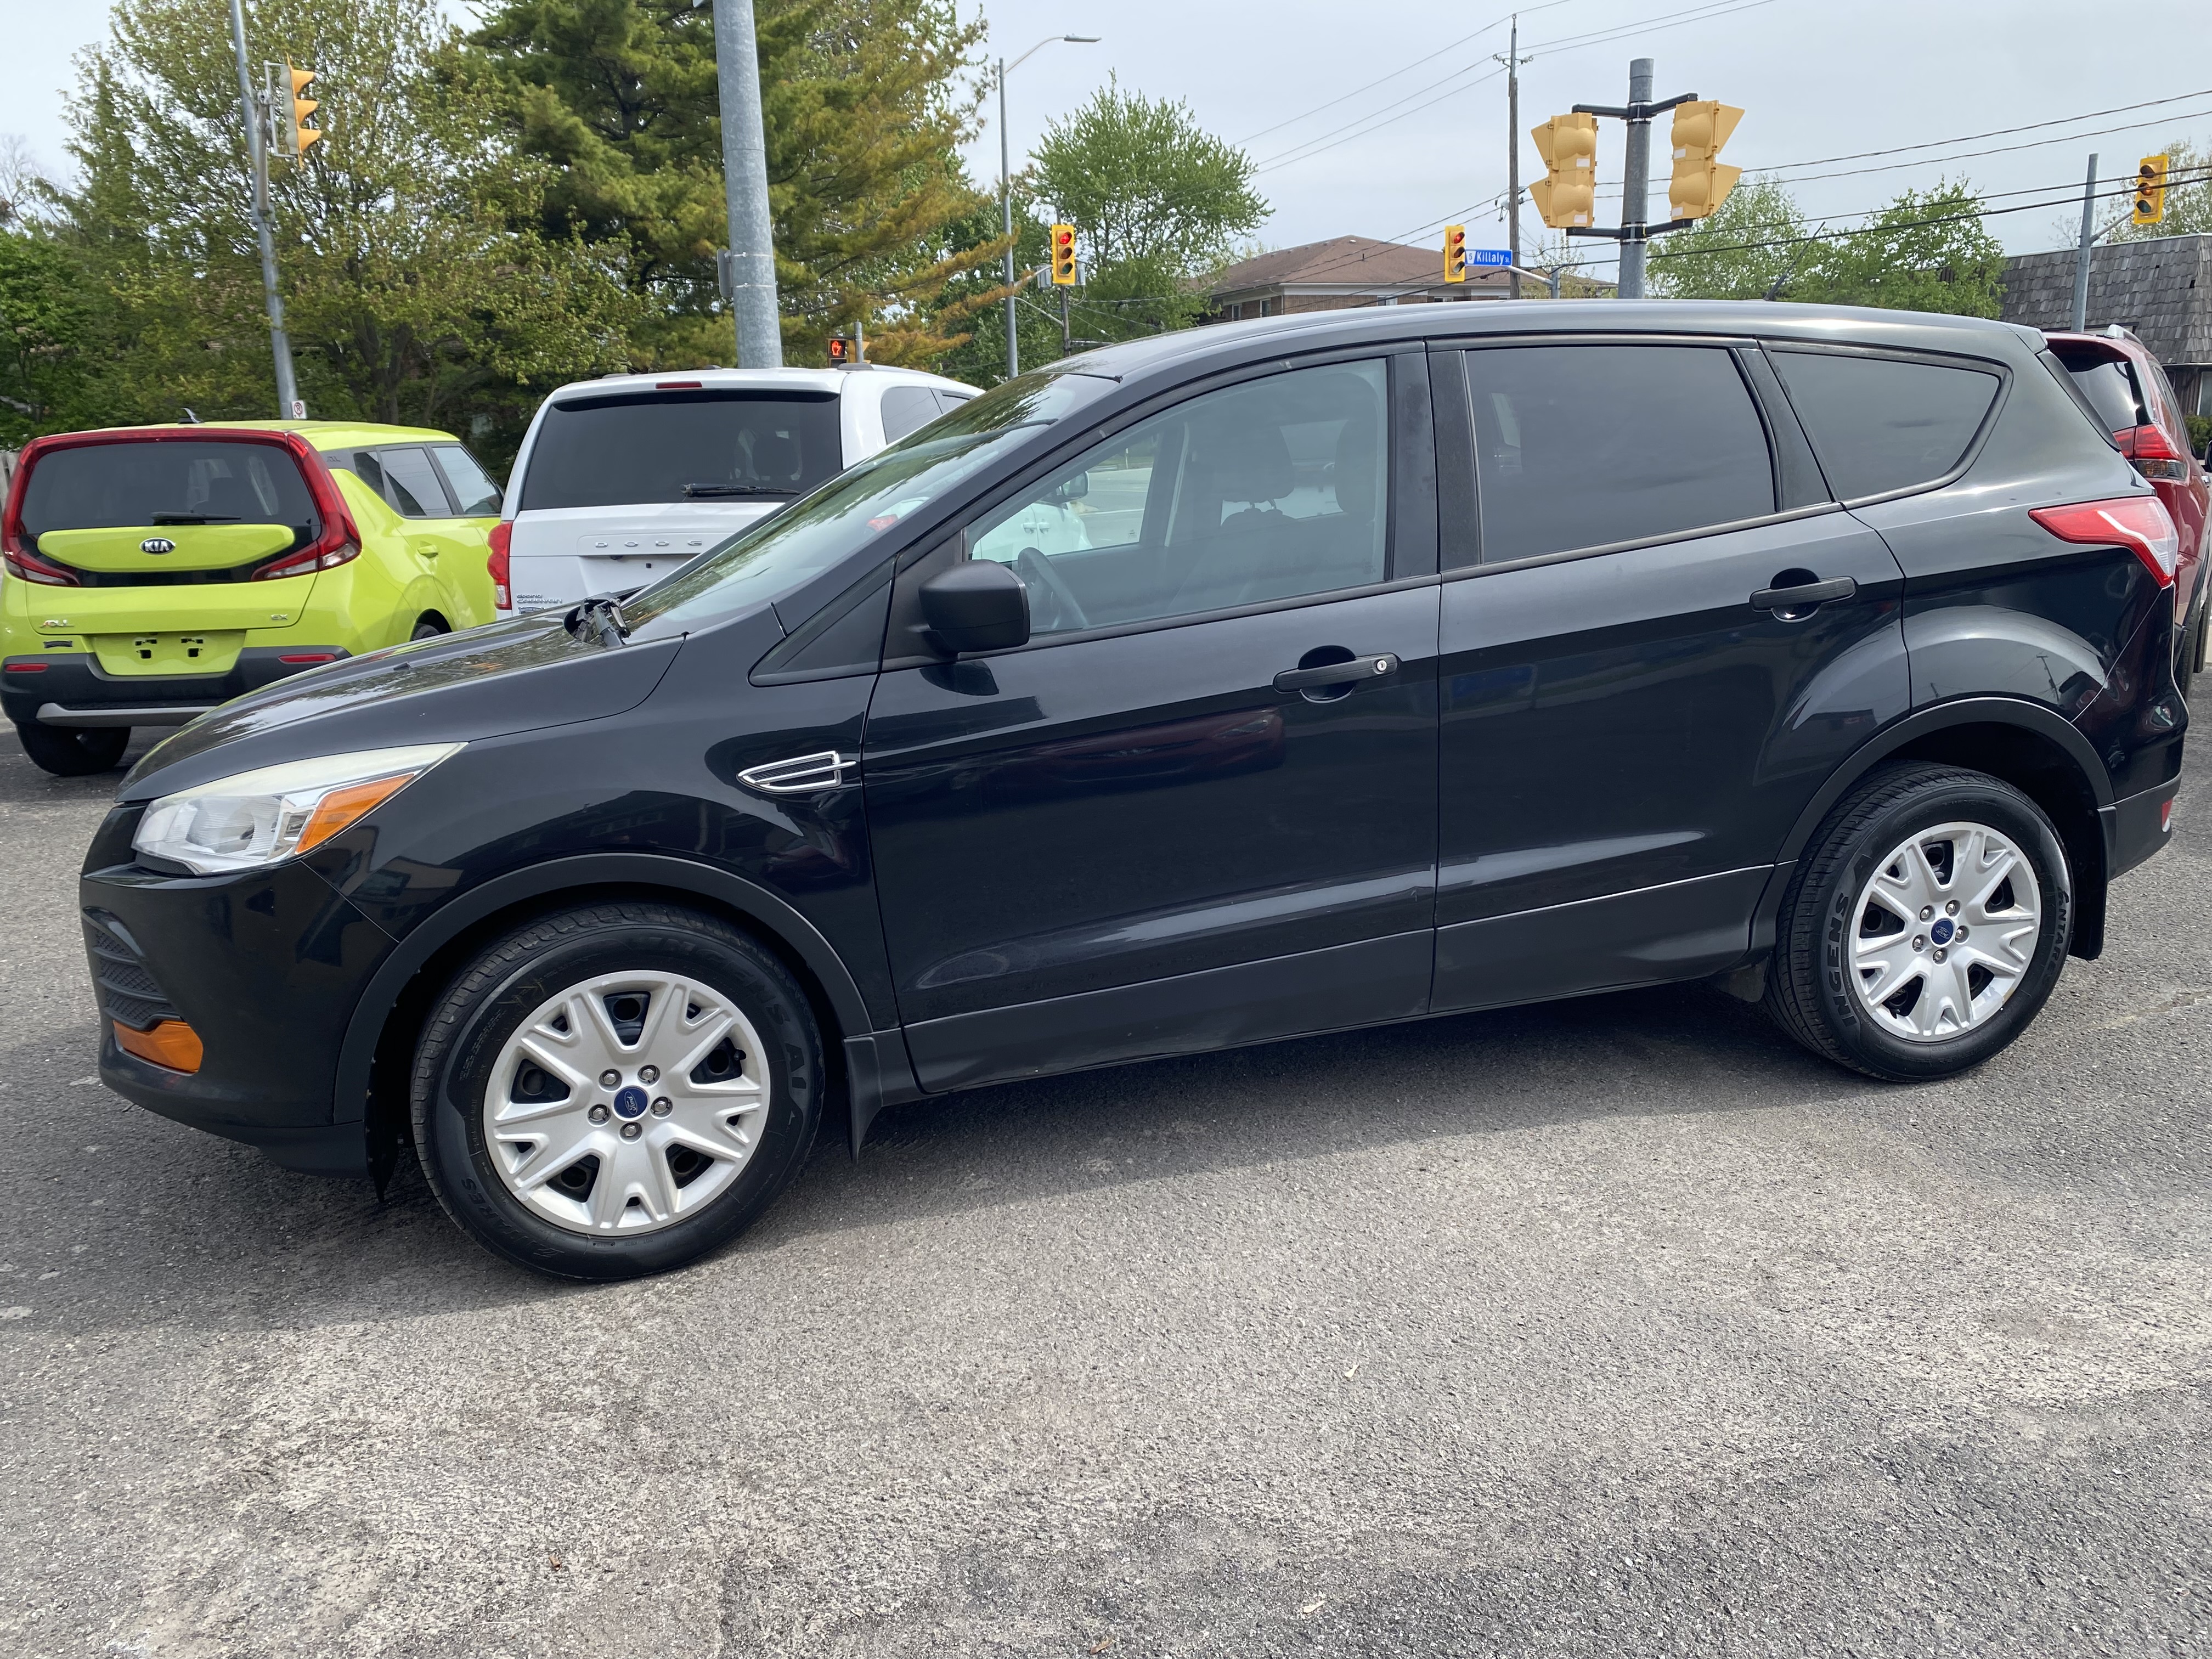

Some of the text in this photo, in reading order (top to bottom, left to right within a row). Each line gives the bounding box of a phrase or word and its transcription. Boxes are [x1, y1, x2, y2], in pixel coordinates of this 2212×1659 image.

[1476, 251, 1504, 266] Killaly
[144, 540, 170, 552] KIA
[595, 539, 724, 548] DODG
[1827, 892, 1858, 1028] INGENS
[626, 1095, 636, 1111] Ford
